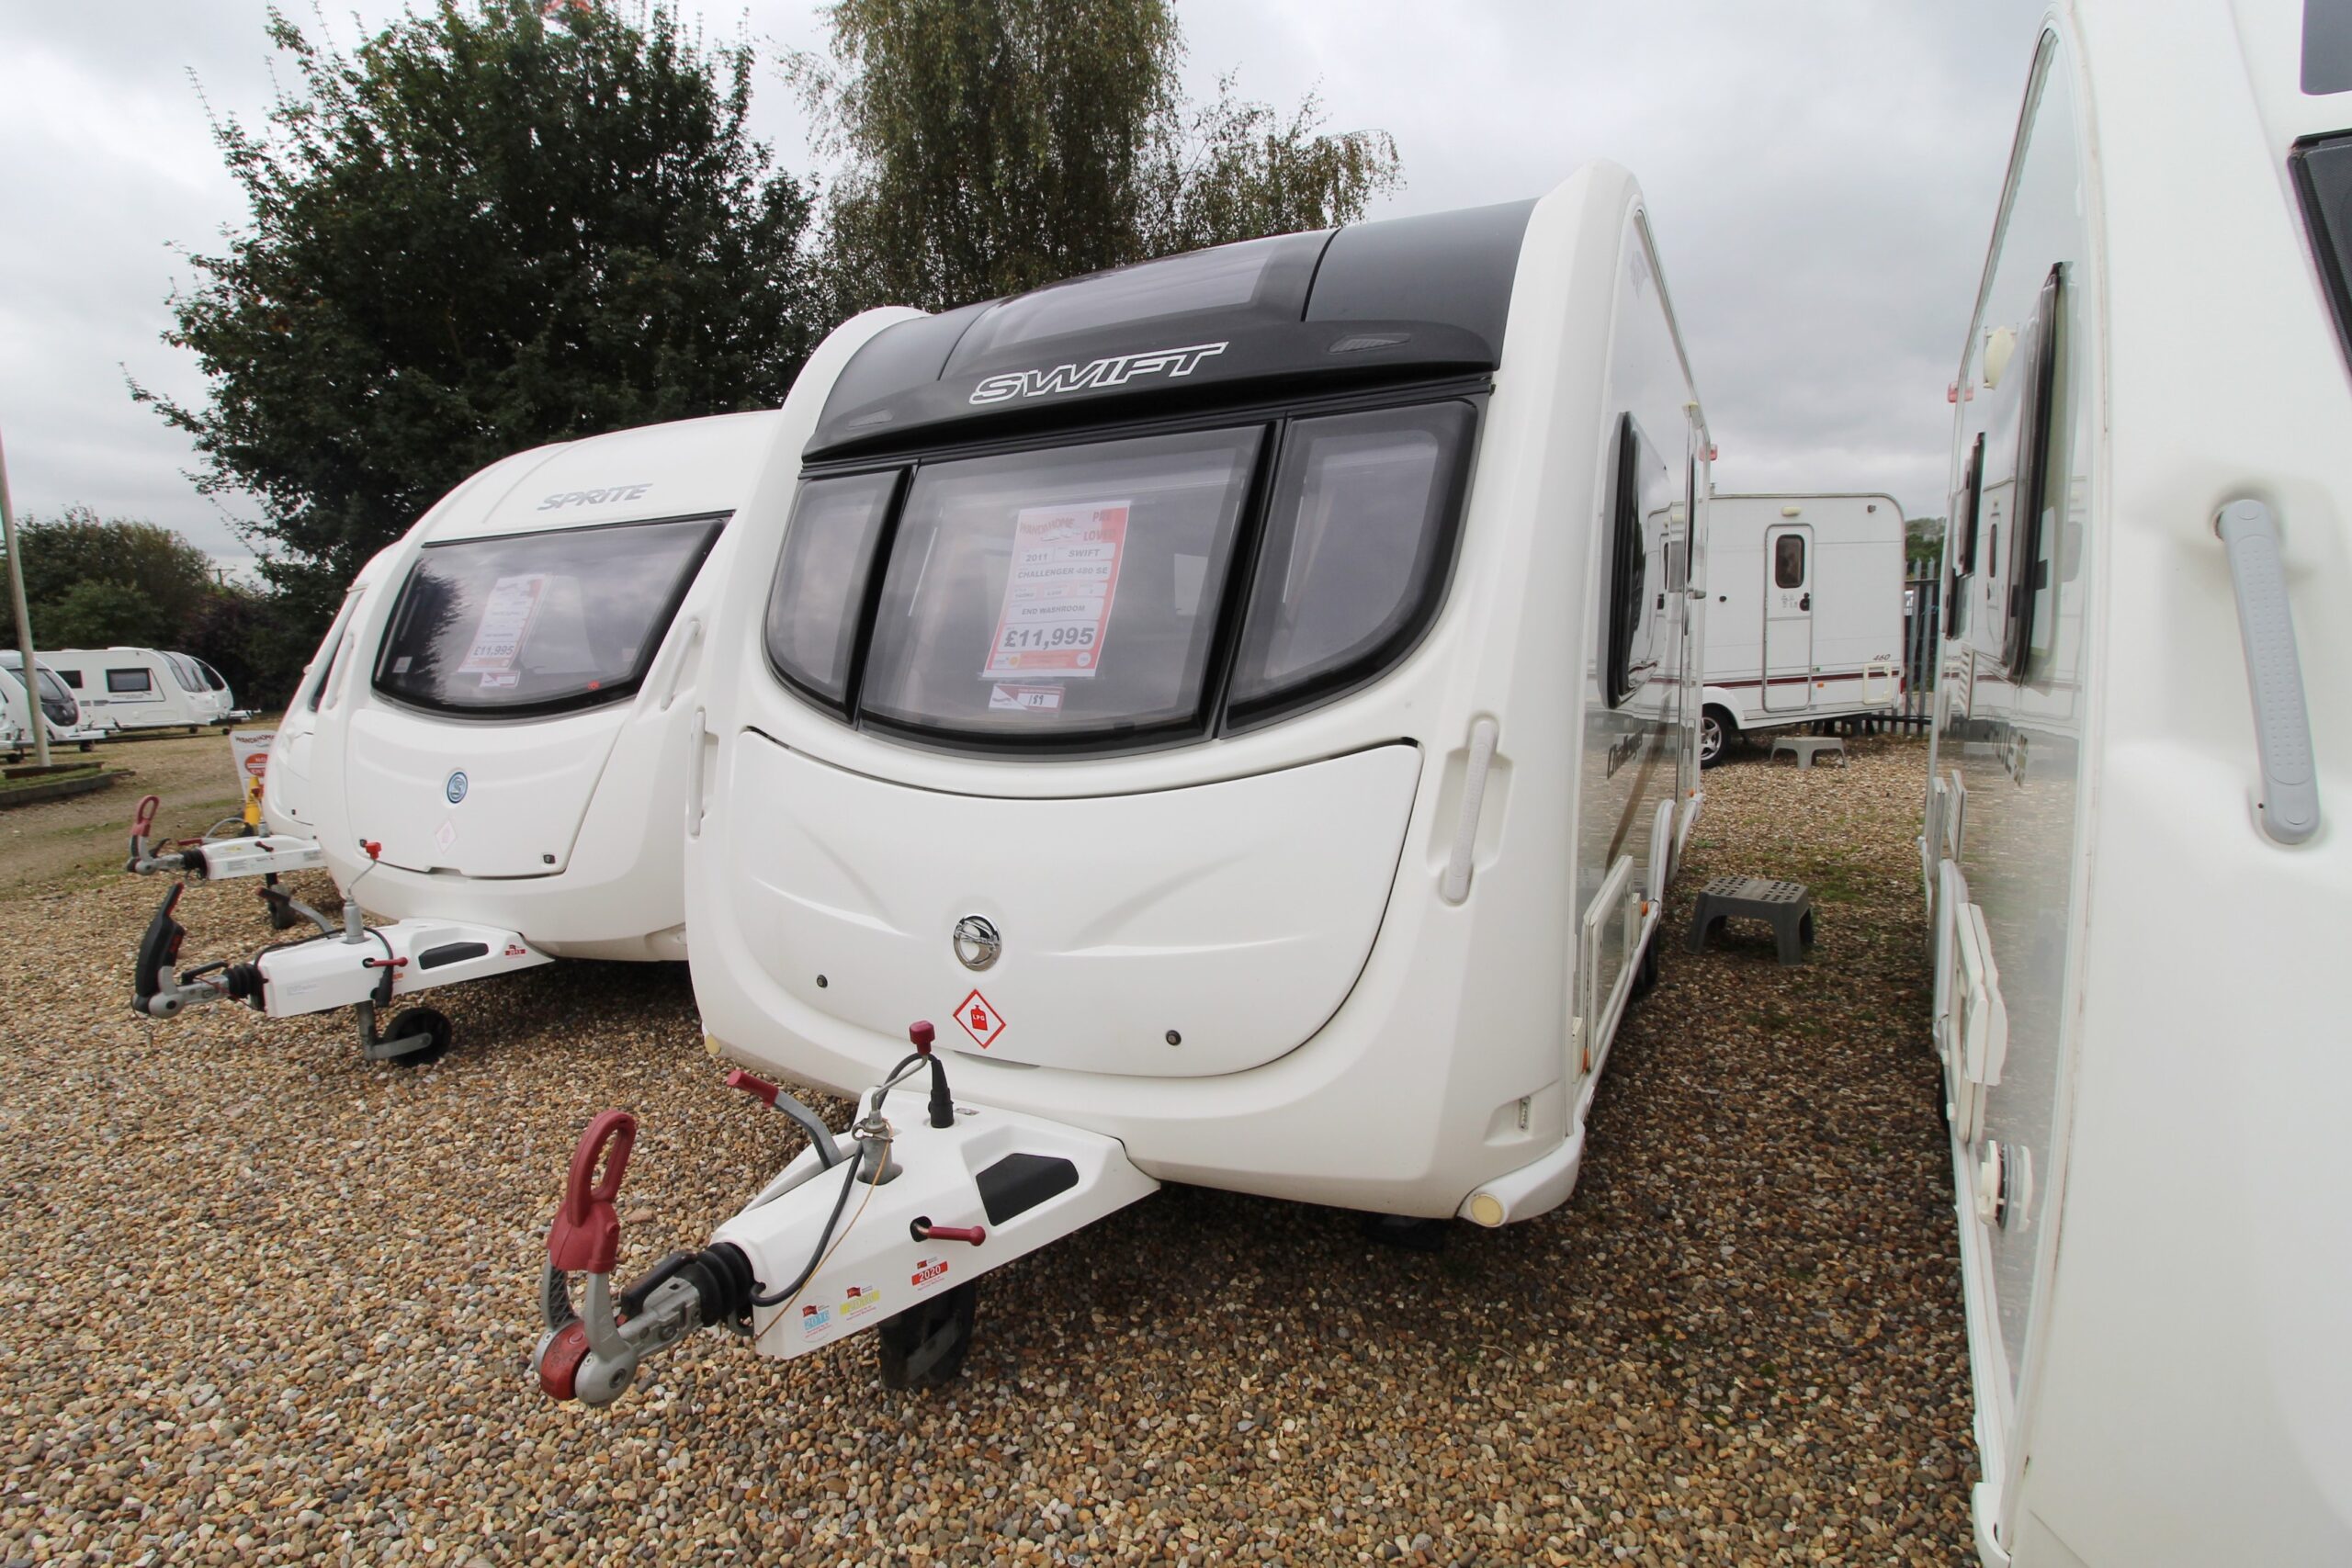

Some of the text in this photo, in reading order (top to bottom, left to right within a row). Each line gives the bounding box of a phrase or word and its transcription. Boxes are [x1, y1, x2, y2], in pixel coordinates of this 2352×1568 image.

[968, 341, 1229, 404] SWIFT
[537, 483, 653, 511] SPRITE
[1025, 548, 1101, 562] 2011 SWIFT
[1017, 567, 1074, 579] CHALLENGER
[1096, 566, 1108, 574] SE
[1022, 604, 1085, 615] END WASHROOM
[1004, 626, 1094, 650] £11,995
[919, 1265, 942, 1282] 2020
